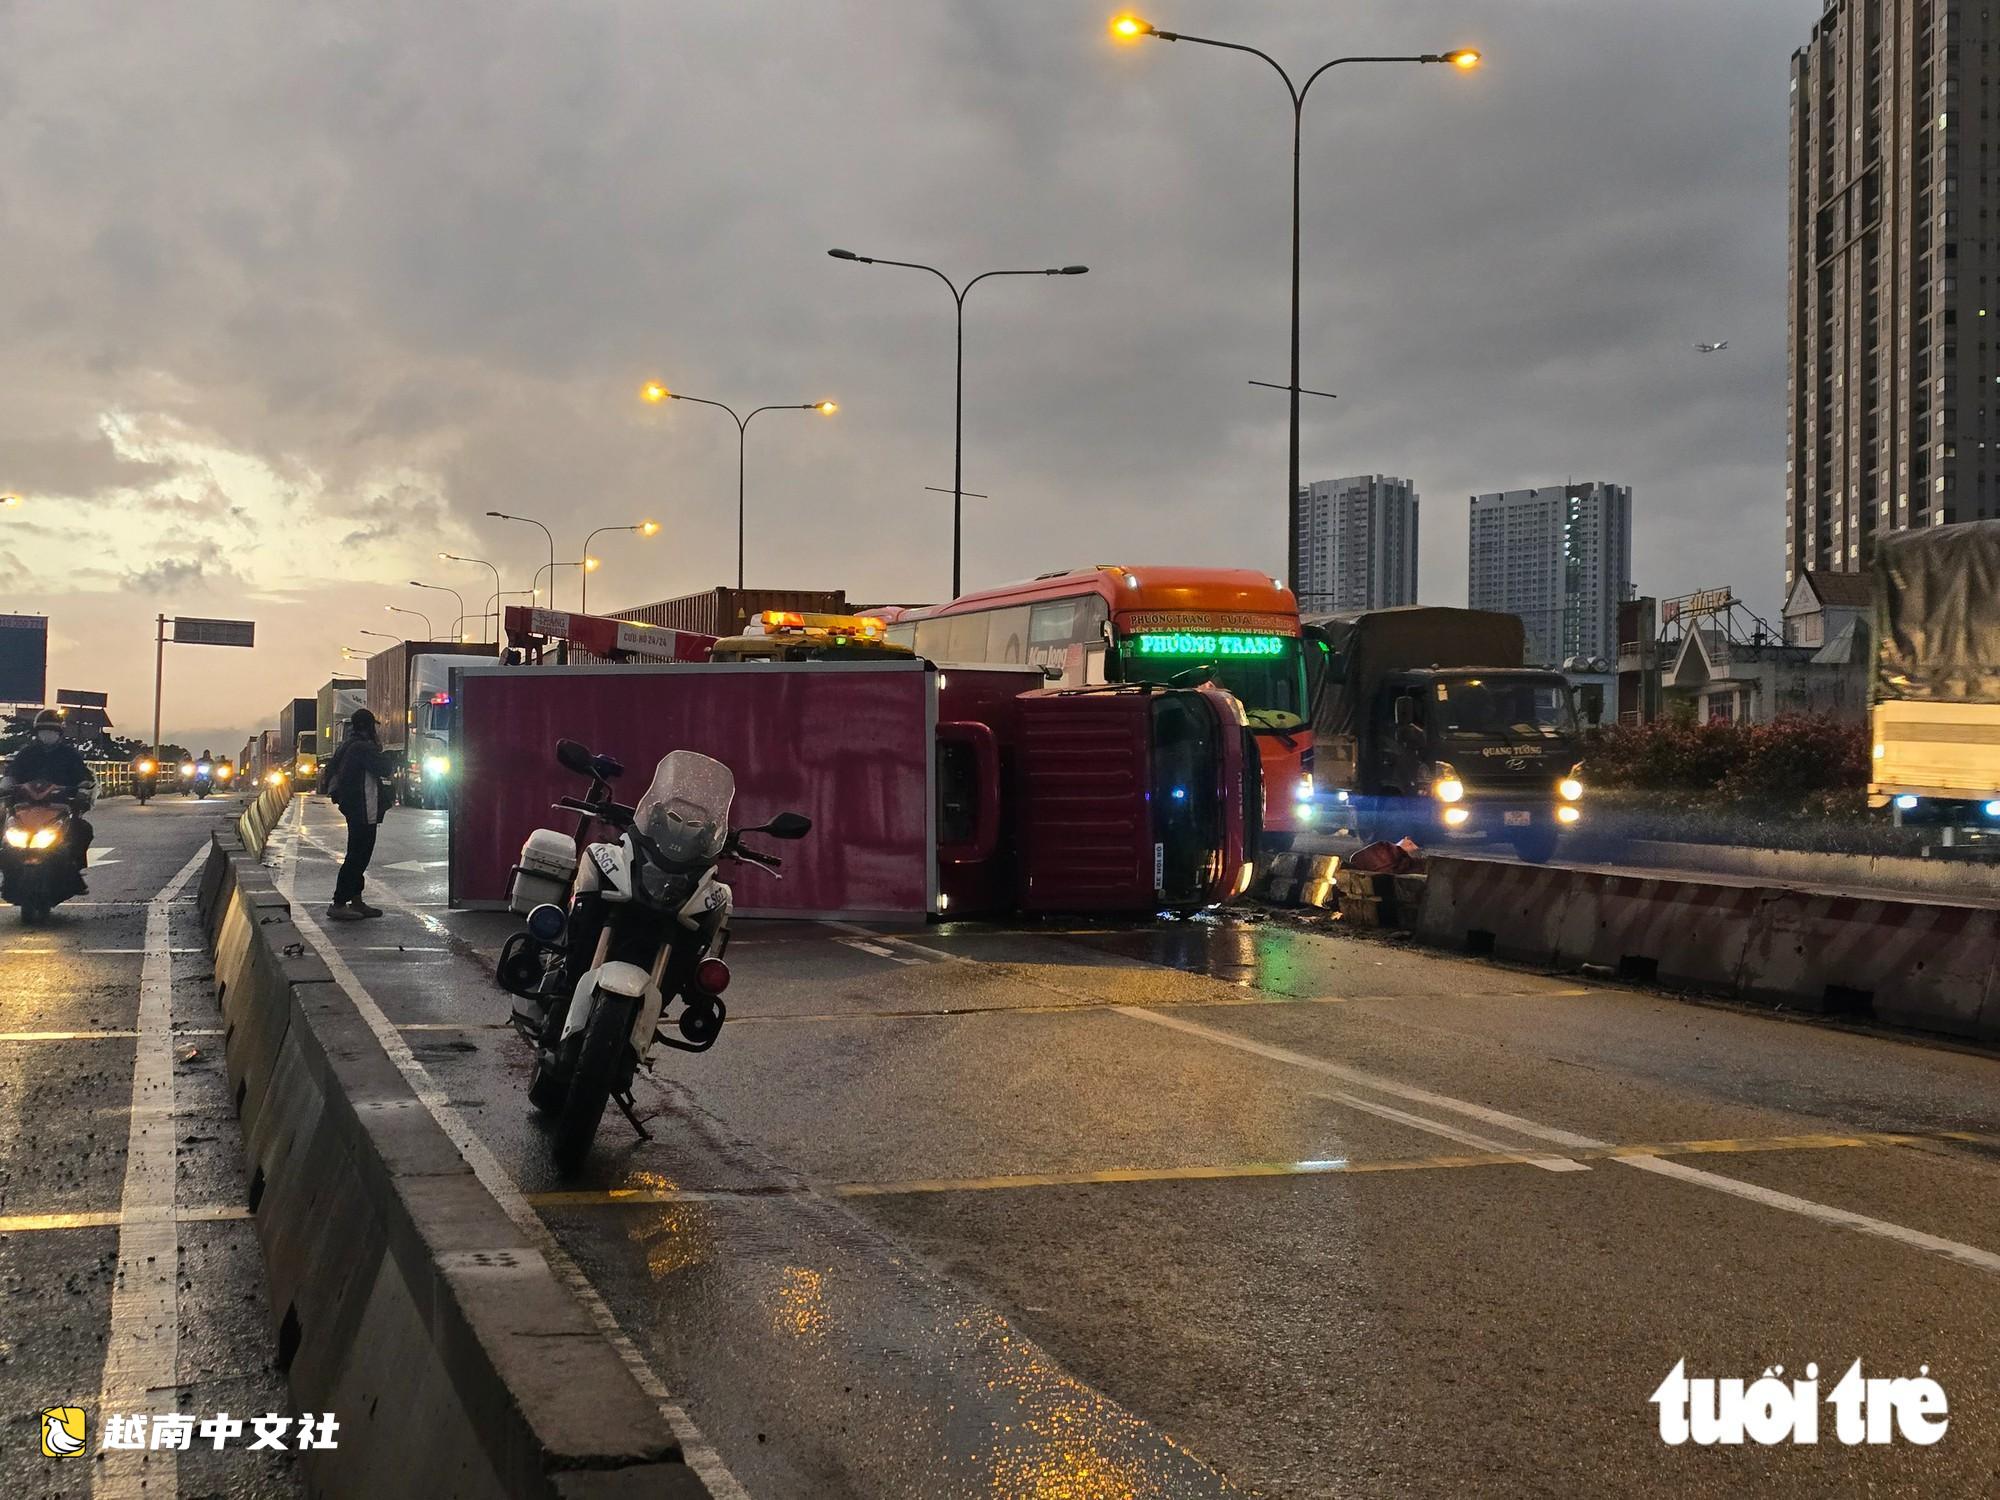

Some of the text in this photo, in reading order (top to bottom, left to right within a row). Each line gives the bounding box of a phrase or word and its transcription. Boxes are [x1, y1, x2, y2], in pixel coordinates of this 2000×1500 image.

[1175, 614, 1211, 625] TRANG
[1220, 615, 1251, 625] FUTA
[1218, 636, 1284, 654] TRANG
[1482, 746, 1512, 758] QUANG
[595, 847, 619, 876] CSGT
